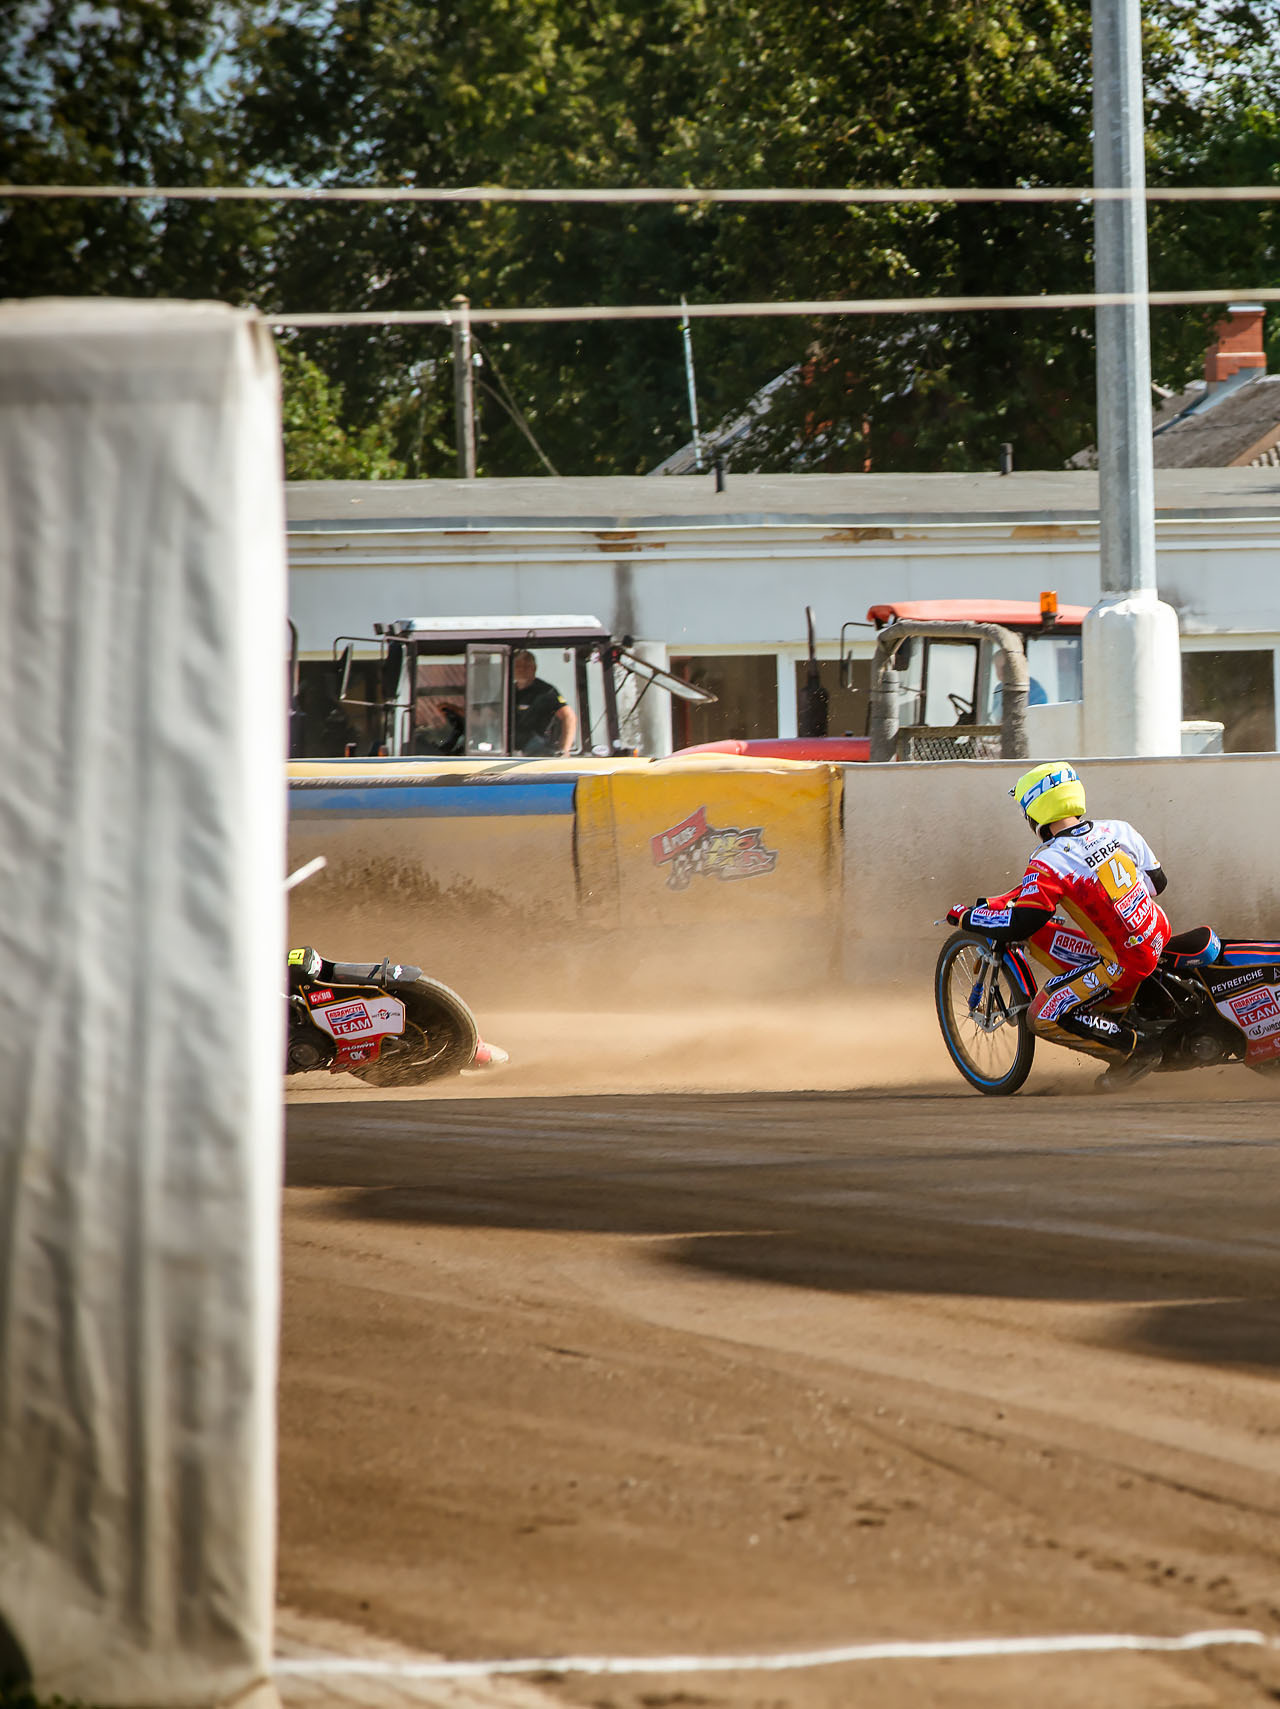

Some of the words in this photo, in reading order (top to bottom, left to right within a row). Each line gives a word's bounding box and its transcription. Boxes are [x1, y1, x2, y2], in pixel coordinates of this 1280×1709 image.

[1108, 858, 1133, 889] 4
[1211, 968, 1264, 994] PEYREFICHE
[333, 1018, 371, 1034] TEAM
[1240, 1005, 1279, 1025] TEAM
